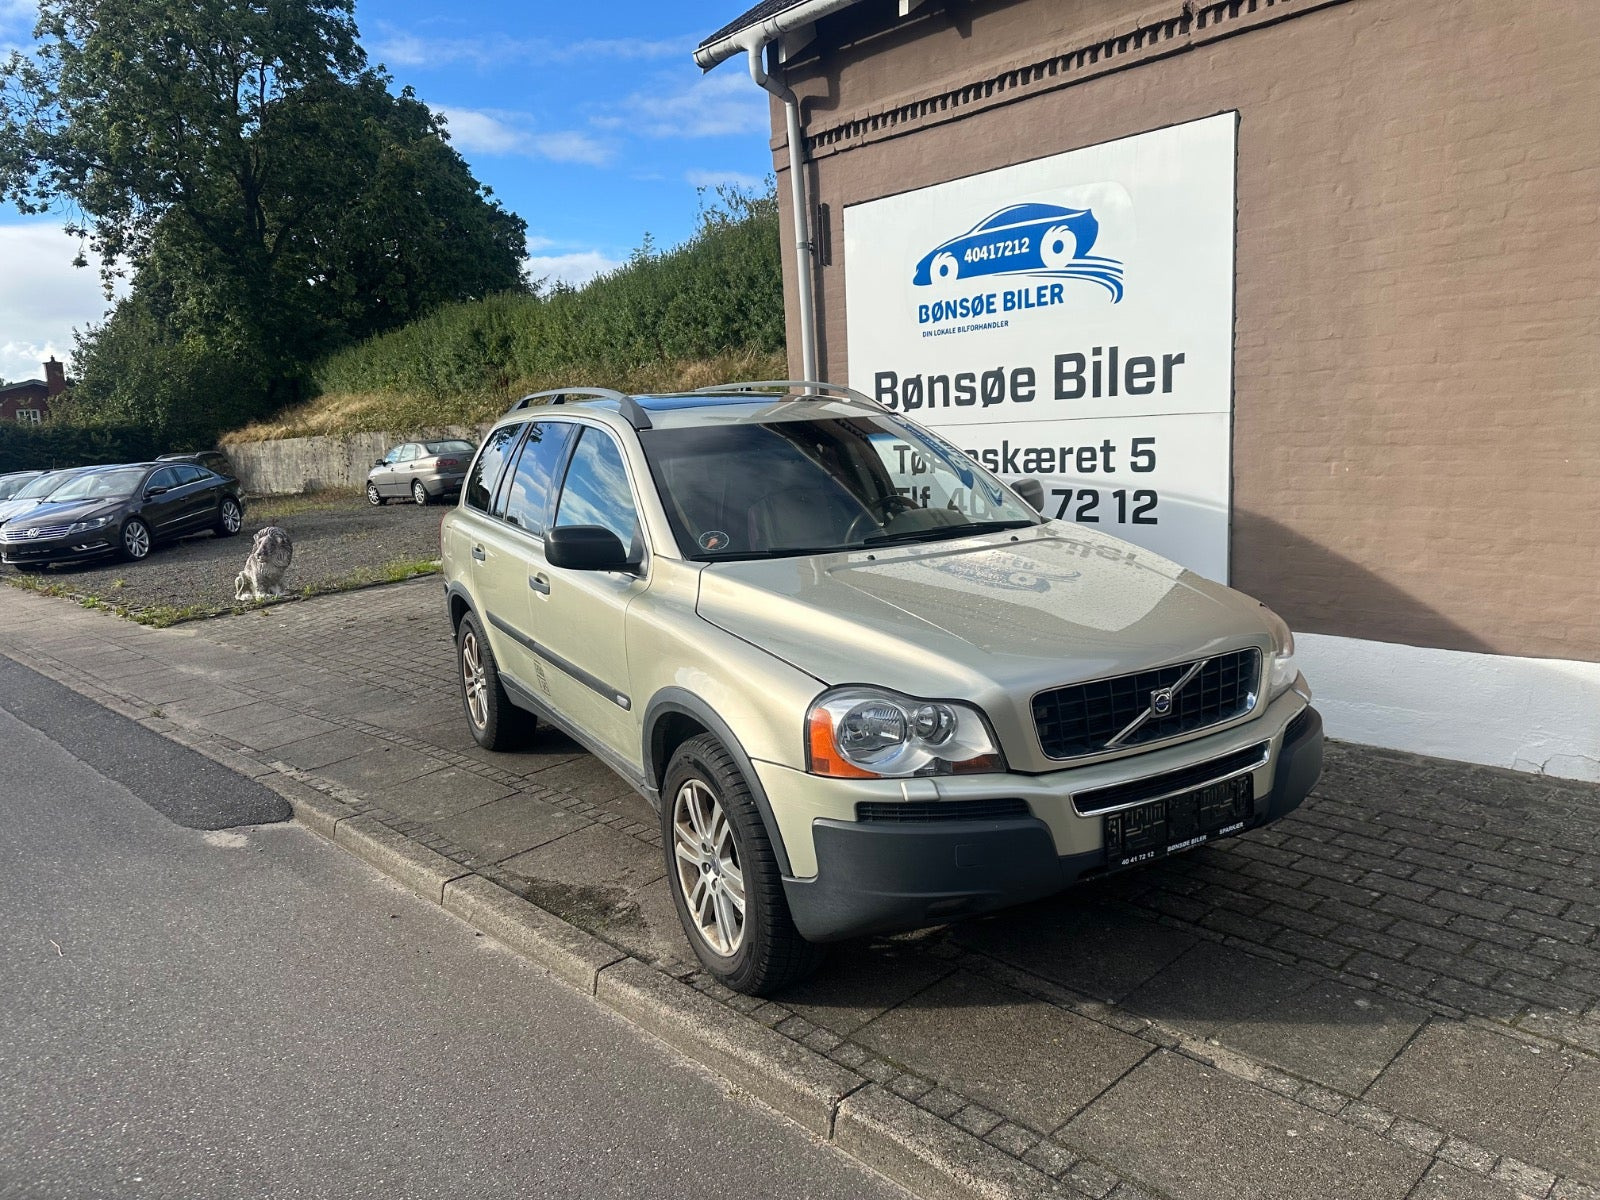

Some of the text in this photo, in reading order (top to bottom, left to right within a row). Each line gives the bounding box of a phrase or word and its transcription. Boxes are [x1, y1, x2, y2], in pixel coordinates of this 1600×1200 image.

[964, 237, 1030, 264] 40417212
[918, 283, 1064, 324] BØNSØE BILER
[933, 327, 957, 337] LOKALE
[957, 320, 1009, 333] BILFORHANDLER
[874, 346, 1185, 412] Bønsøe Biler
[1130, 437, 1156, 473] 5
[1051, 489, 1100, 523] 72
[1112, 489, 1158, 525] 12
